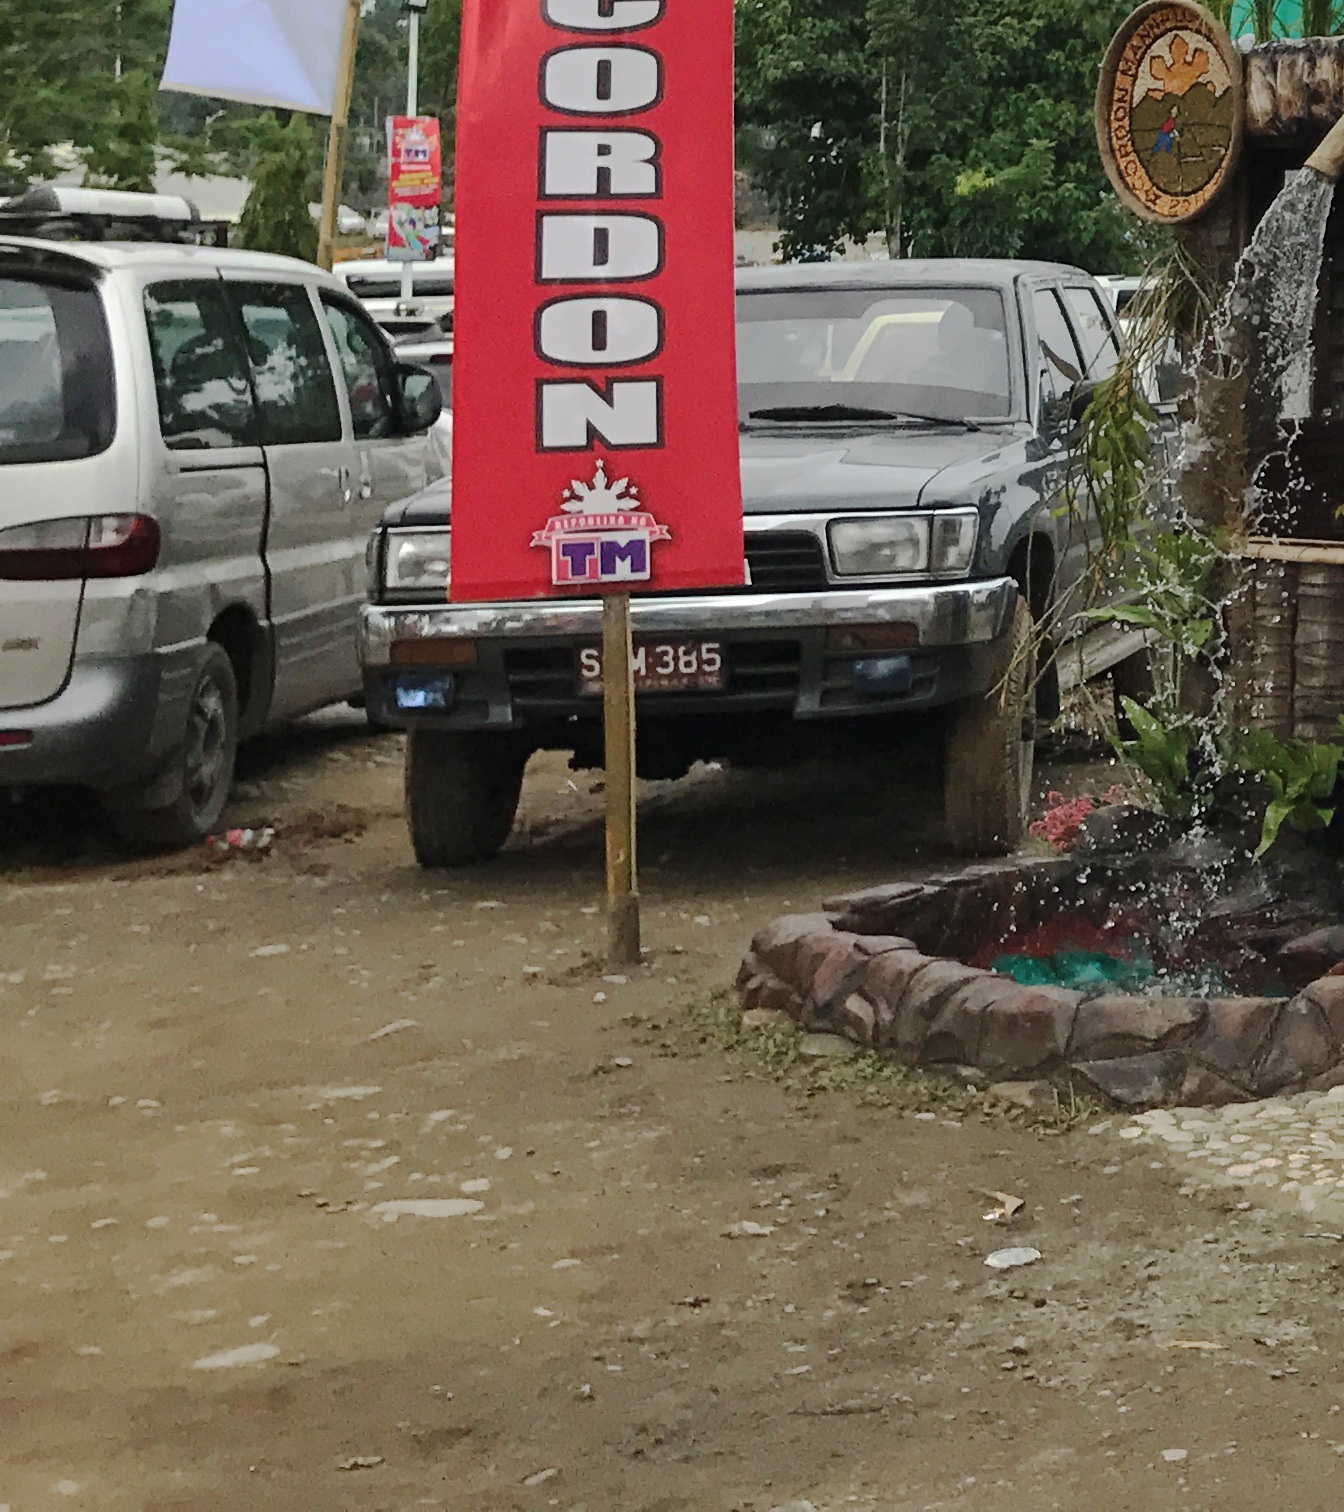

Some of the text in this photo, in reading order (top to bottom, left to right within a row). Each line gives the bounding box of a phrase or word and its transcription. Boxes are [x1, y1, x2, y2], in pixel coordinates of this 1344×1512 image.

[1112, 88, 1147, 191] CORDON
[561, 539, 647, 577] TM
[580, 642, 722, 678] SM 385
